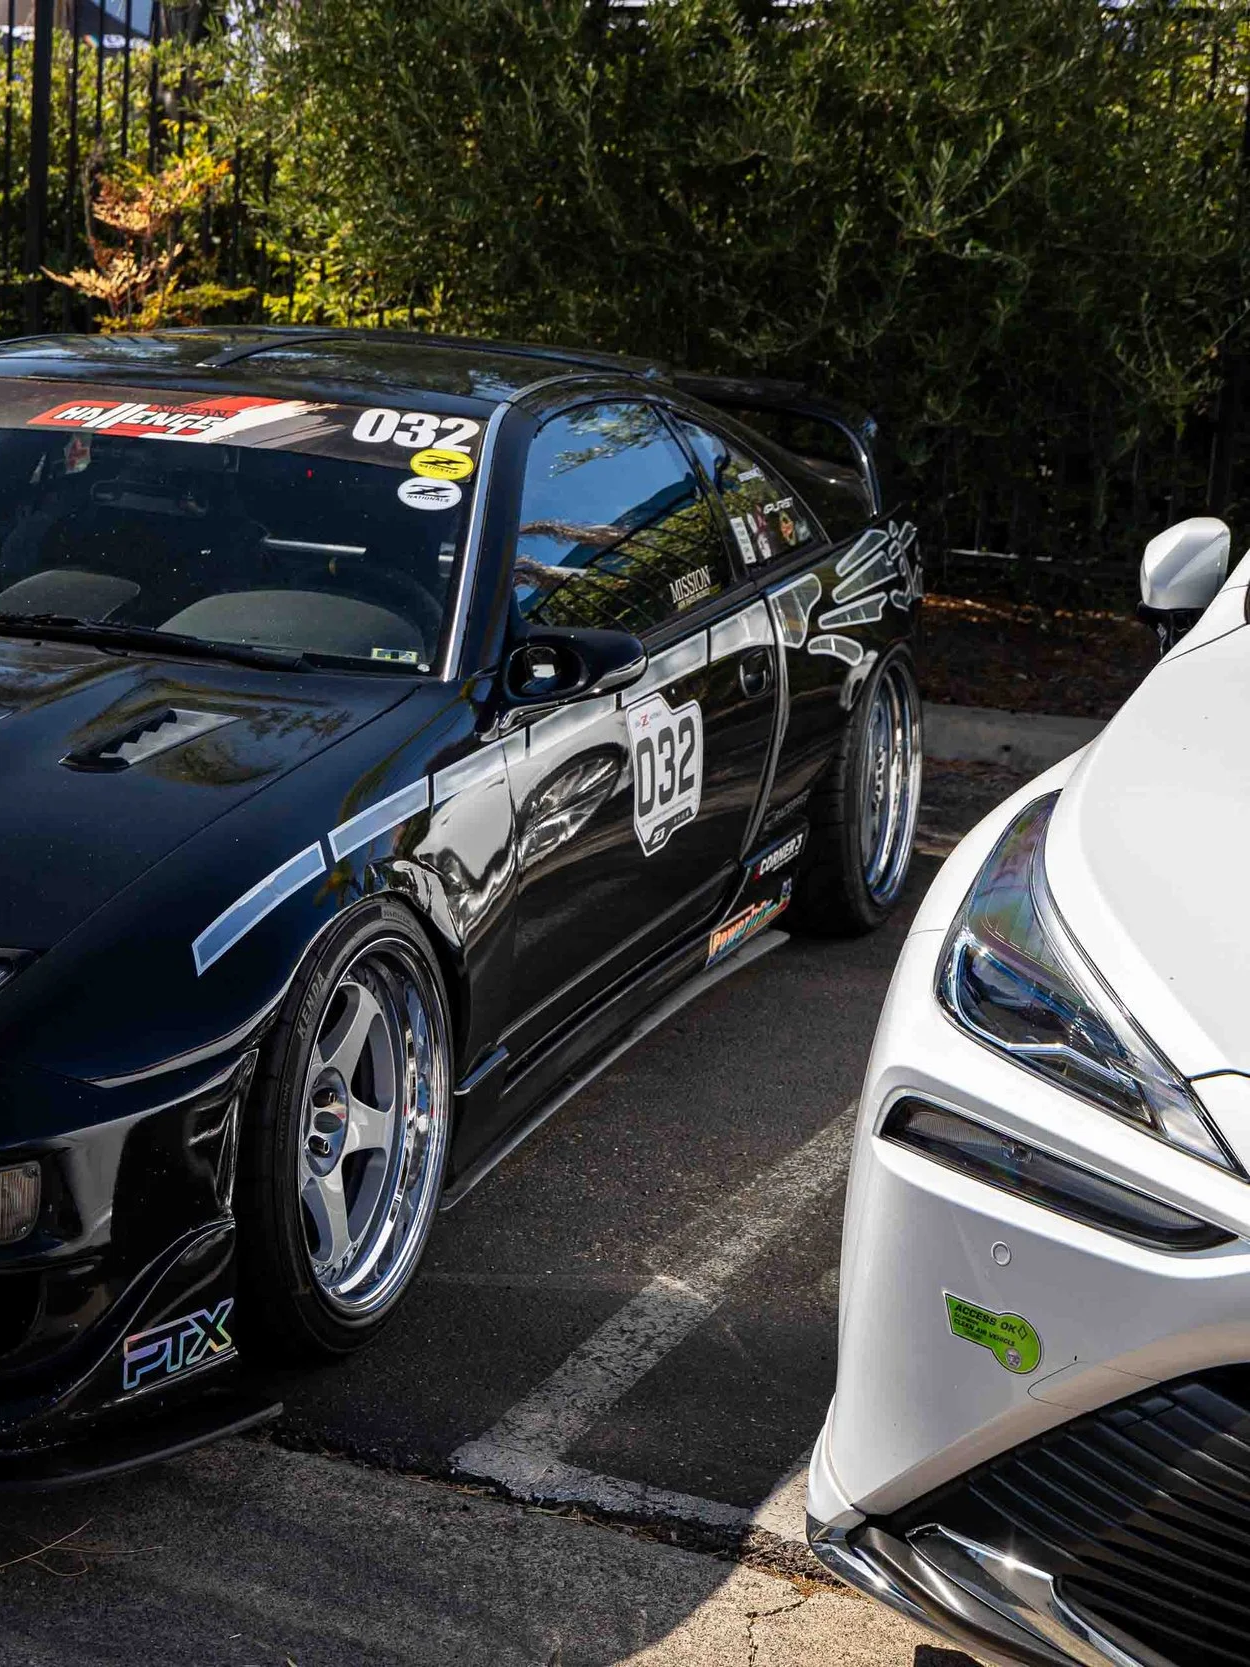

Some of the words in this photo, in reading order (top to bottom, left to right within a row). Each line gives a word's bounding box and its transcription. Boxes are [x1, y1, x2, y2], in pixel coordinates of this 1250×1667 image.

[154, 404, 228, 417] NISSAN
[352, 407, 480, 454] 032
[418, 463, 459, 475] NATIONALS
[406, 494, 450, 503] NATIONALS
[669, 565, 712, 604] MISSION
[636, 716, 696, 818] 032
[297, 972, 327, 1041] KENDA
[953, 1318, 975, 1332] CLEAN
[975, 1325, 988, 1337] AIR
[989, 1331, 1016, 1347] VEHICLE
[954, 1304, 998, 1326] ACCESS
[1000, 1321, 1017, 1334] OK
[123, 1297, 235, 1390] PTX
